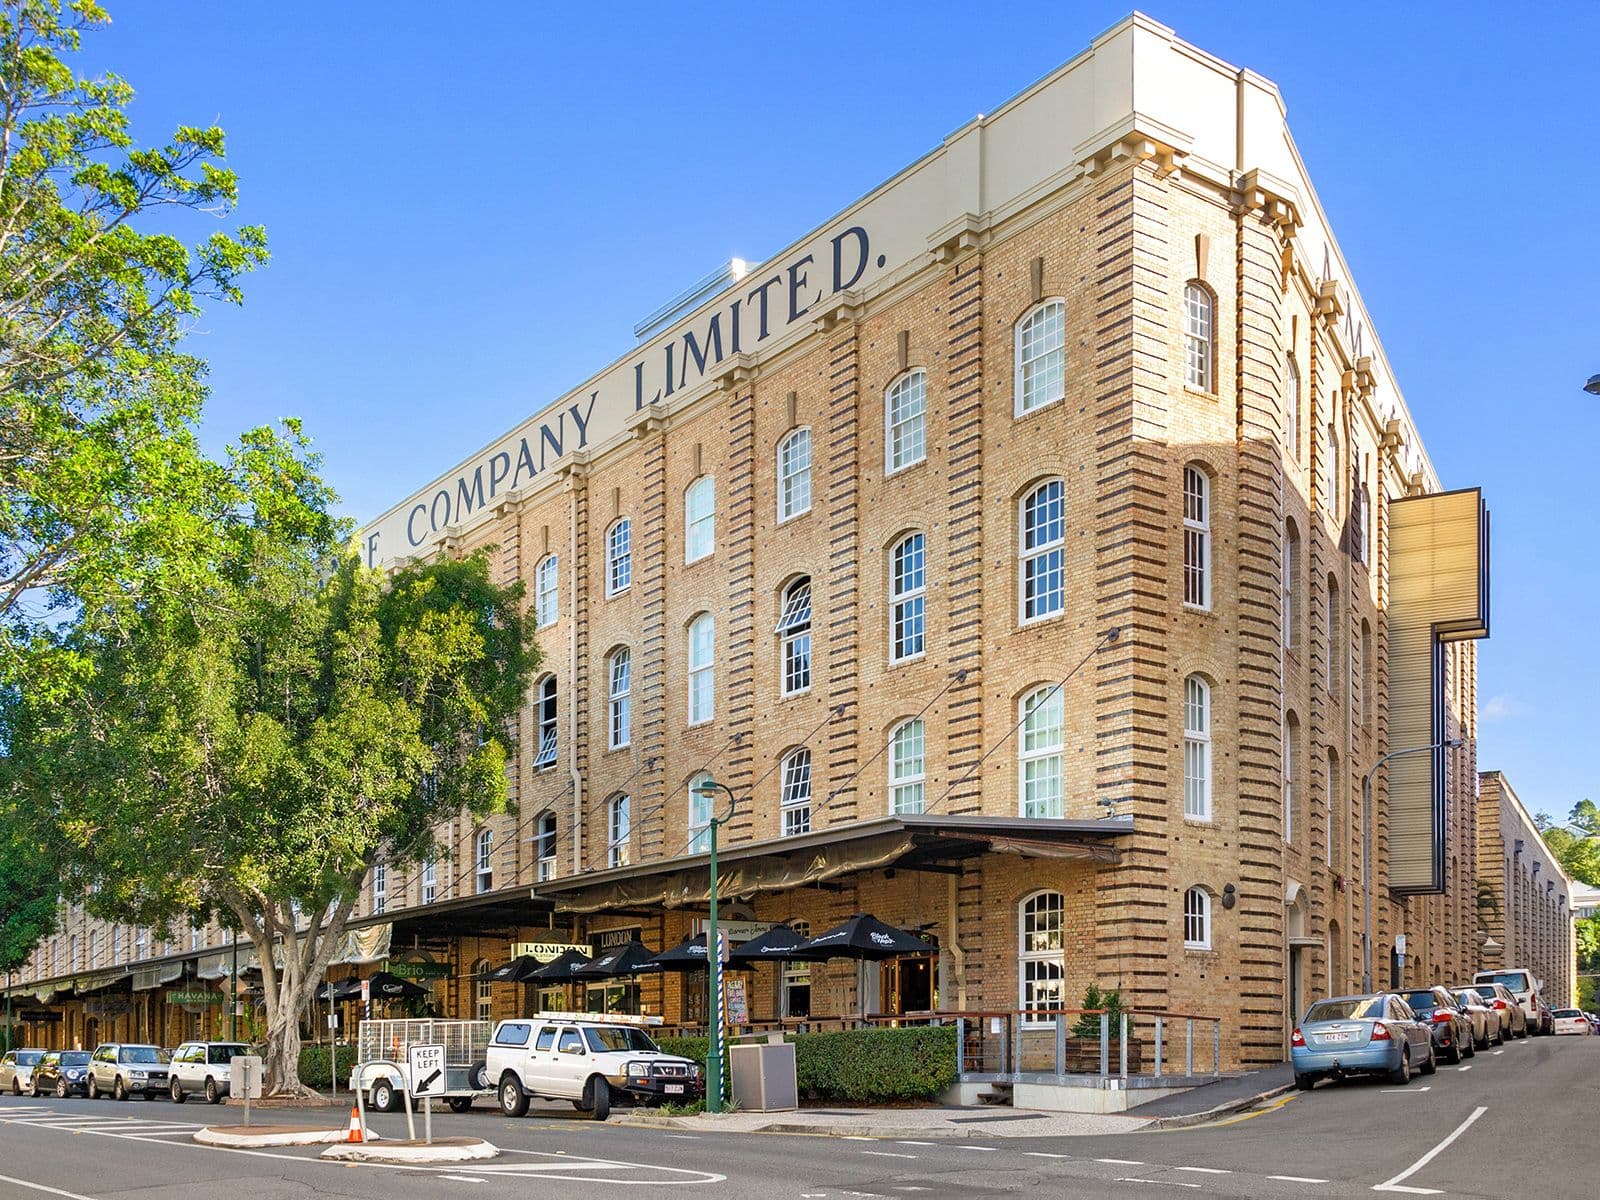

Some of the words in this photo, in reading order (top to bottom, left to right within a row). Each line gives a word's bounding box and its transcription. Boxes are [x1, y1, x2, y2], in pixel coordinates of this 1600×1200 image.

[407, 391, 599, 547] COMPANY
[634, 225, 887, 411] LIMITED.
[601, 930, 632, 948] LONDON
[399, 963, 424, 976] Brio
[177, 992, 218, 1000] HAVANA
[416, 1049, 440, 1059] KEEP
[417, 1059, 439, 1069] LEFT
